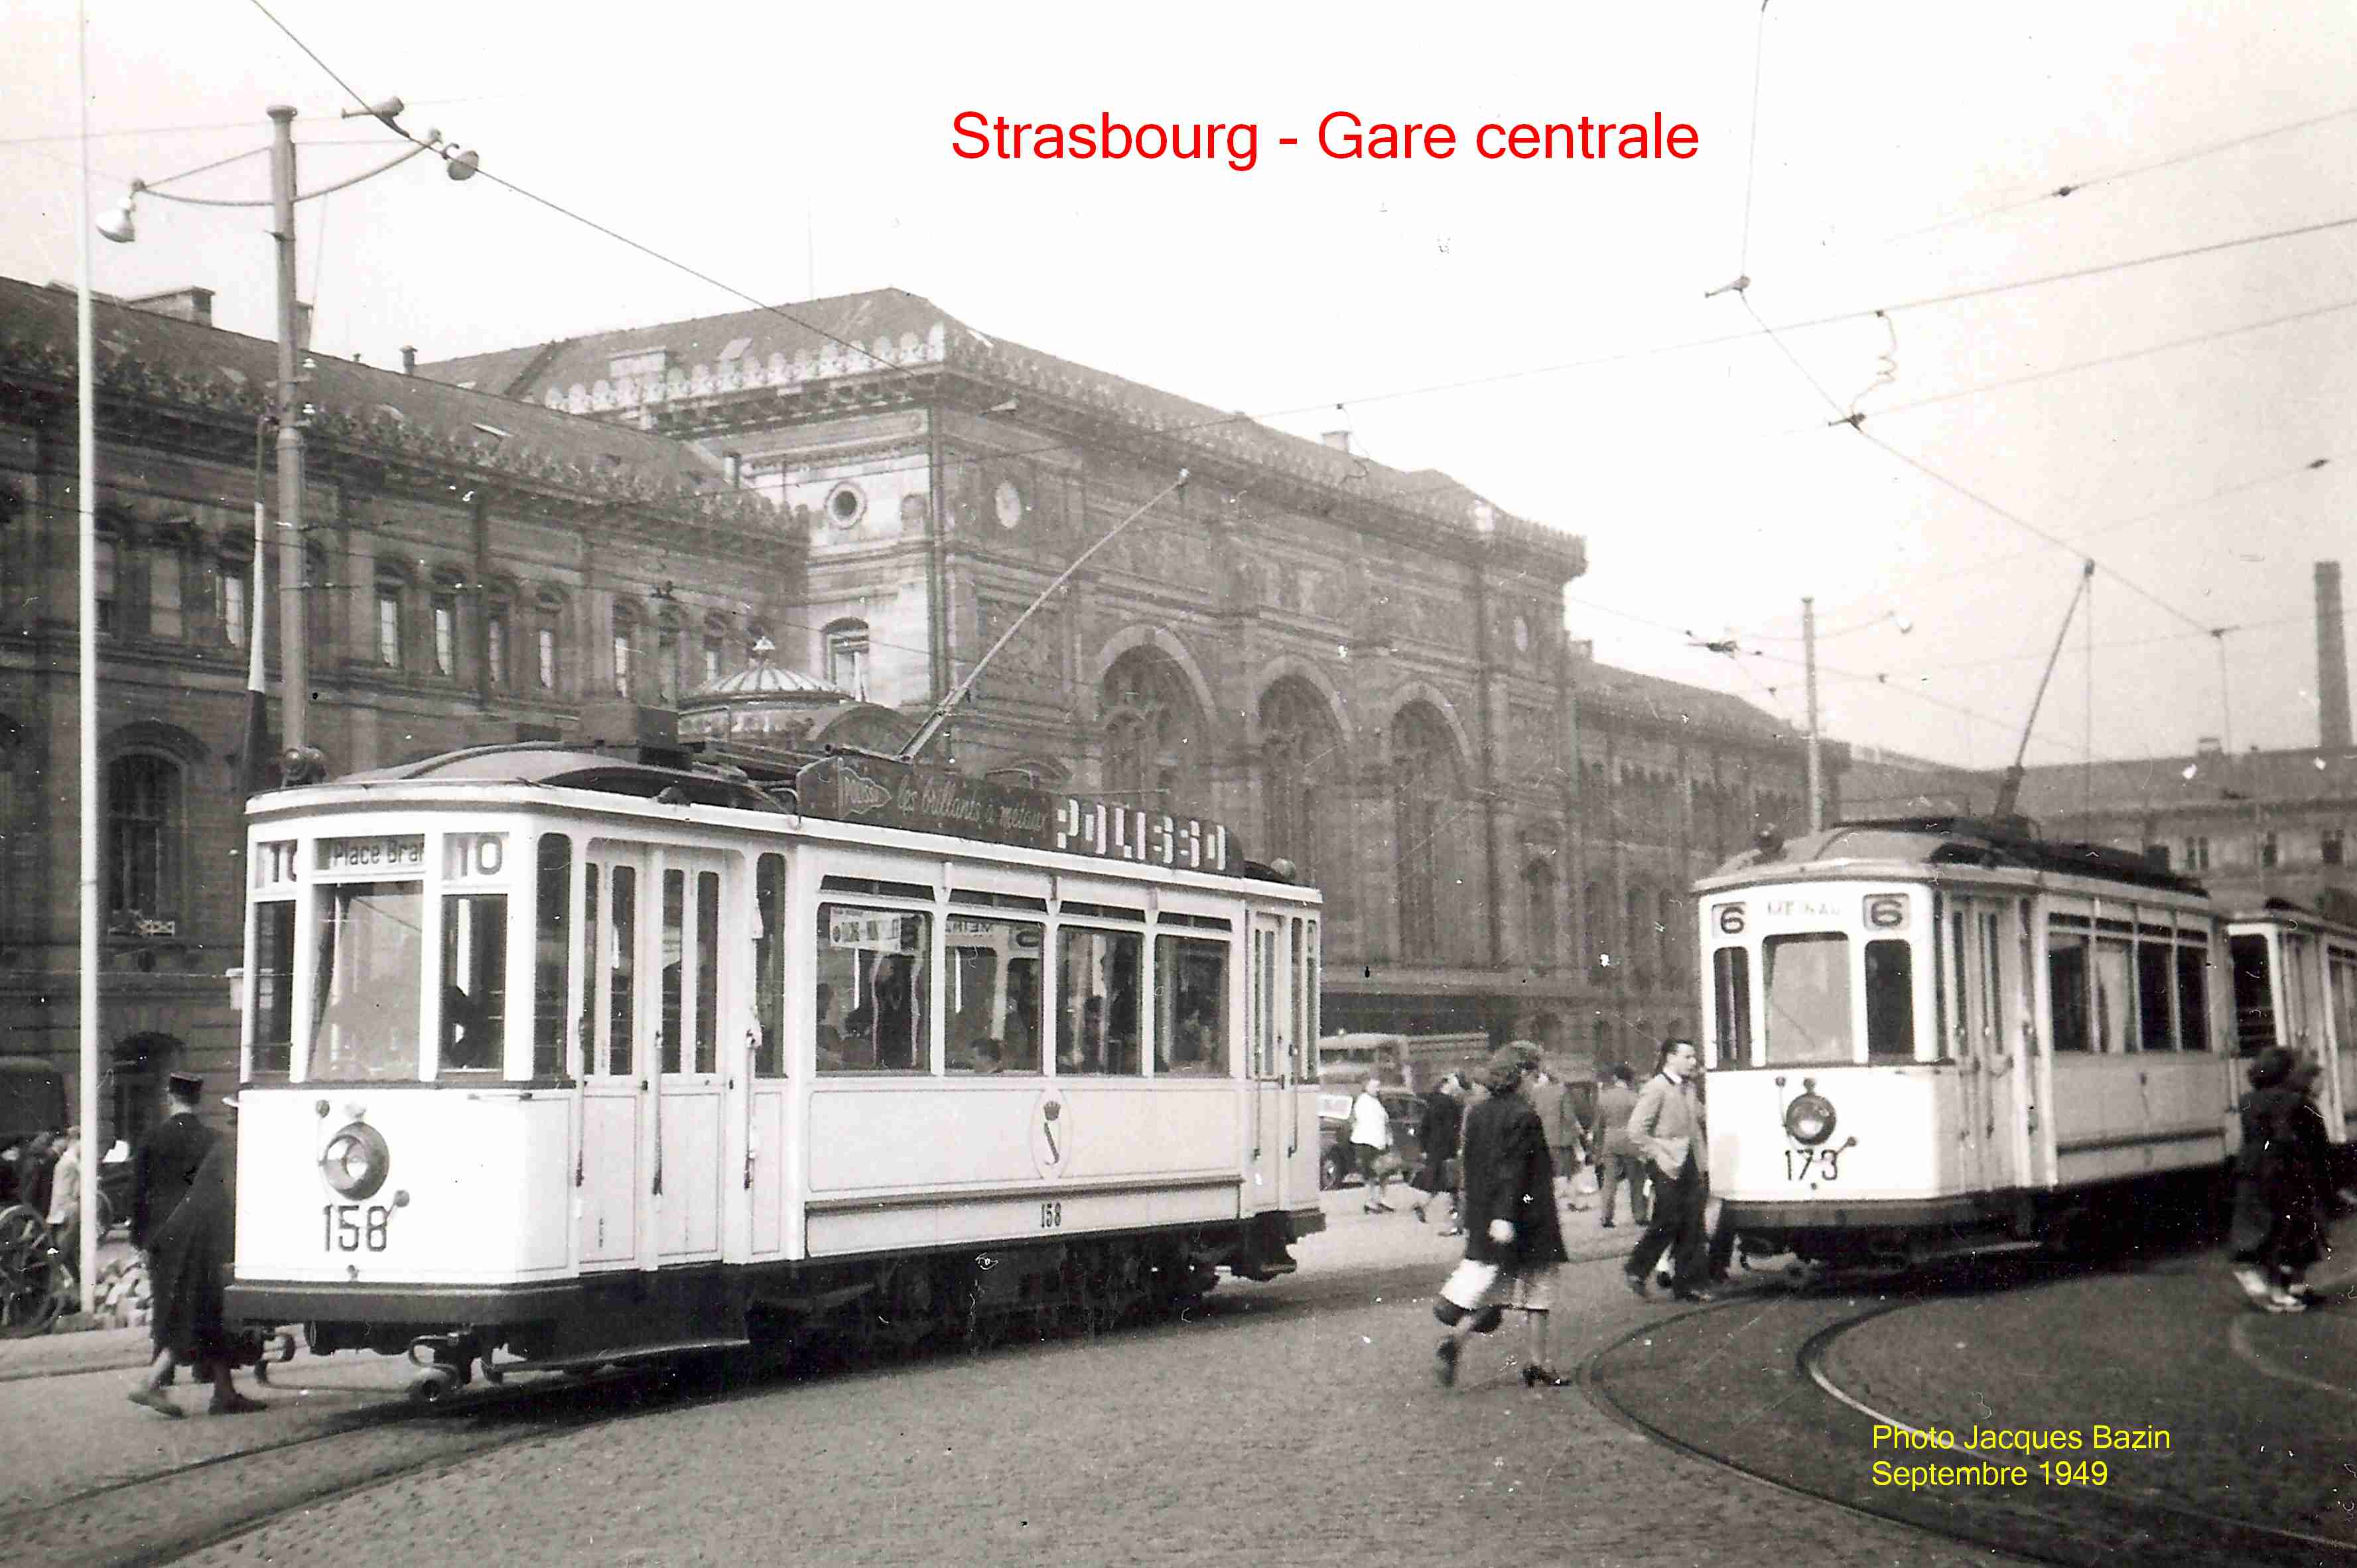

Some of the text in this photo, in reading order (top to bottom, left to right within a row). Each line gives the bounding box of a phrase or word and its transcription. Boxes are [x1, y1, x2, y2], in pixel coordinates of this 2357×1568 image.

[333, 841, 380, 866] Place
[457, 835, 503, 876] 10
[1720, 906, 1746, 934] 6
[1767, 901, 1842, 917] MENAU
[1870, 899, 1904, 927] 6
[1785, 1149, 1838, 1181] 173
[323, 1205, 387, 1252] 158
[1041, 1203, 1061, 1228] 158
